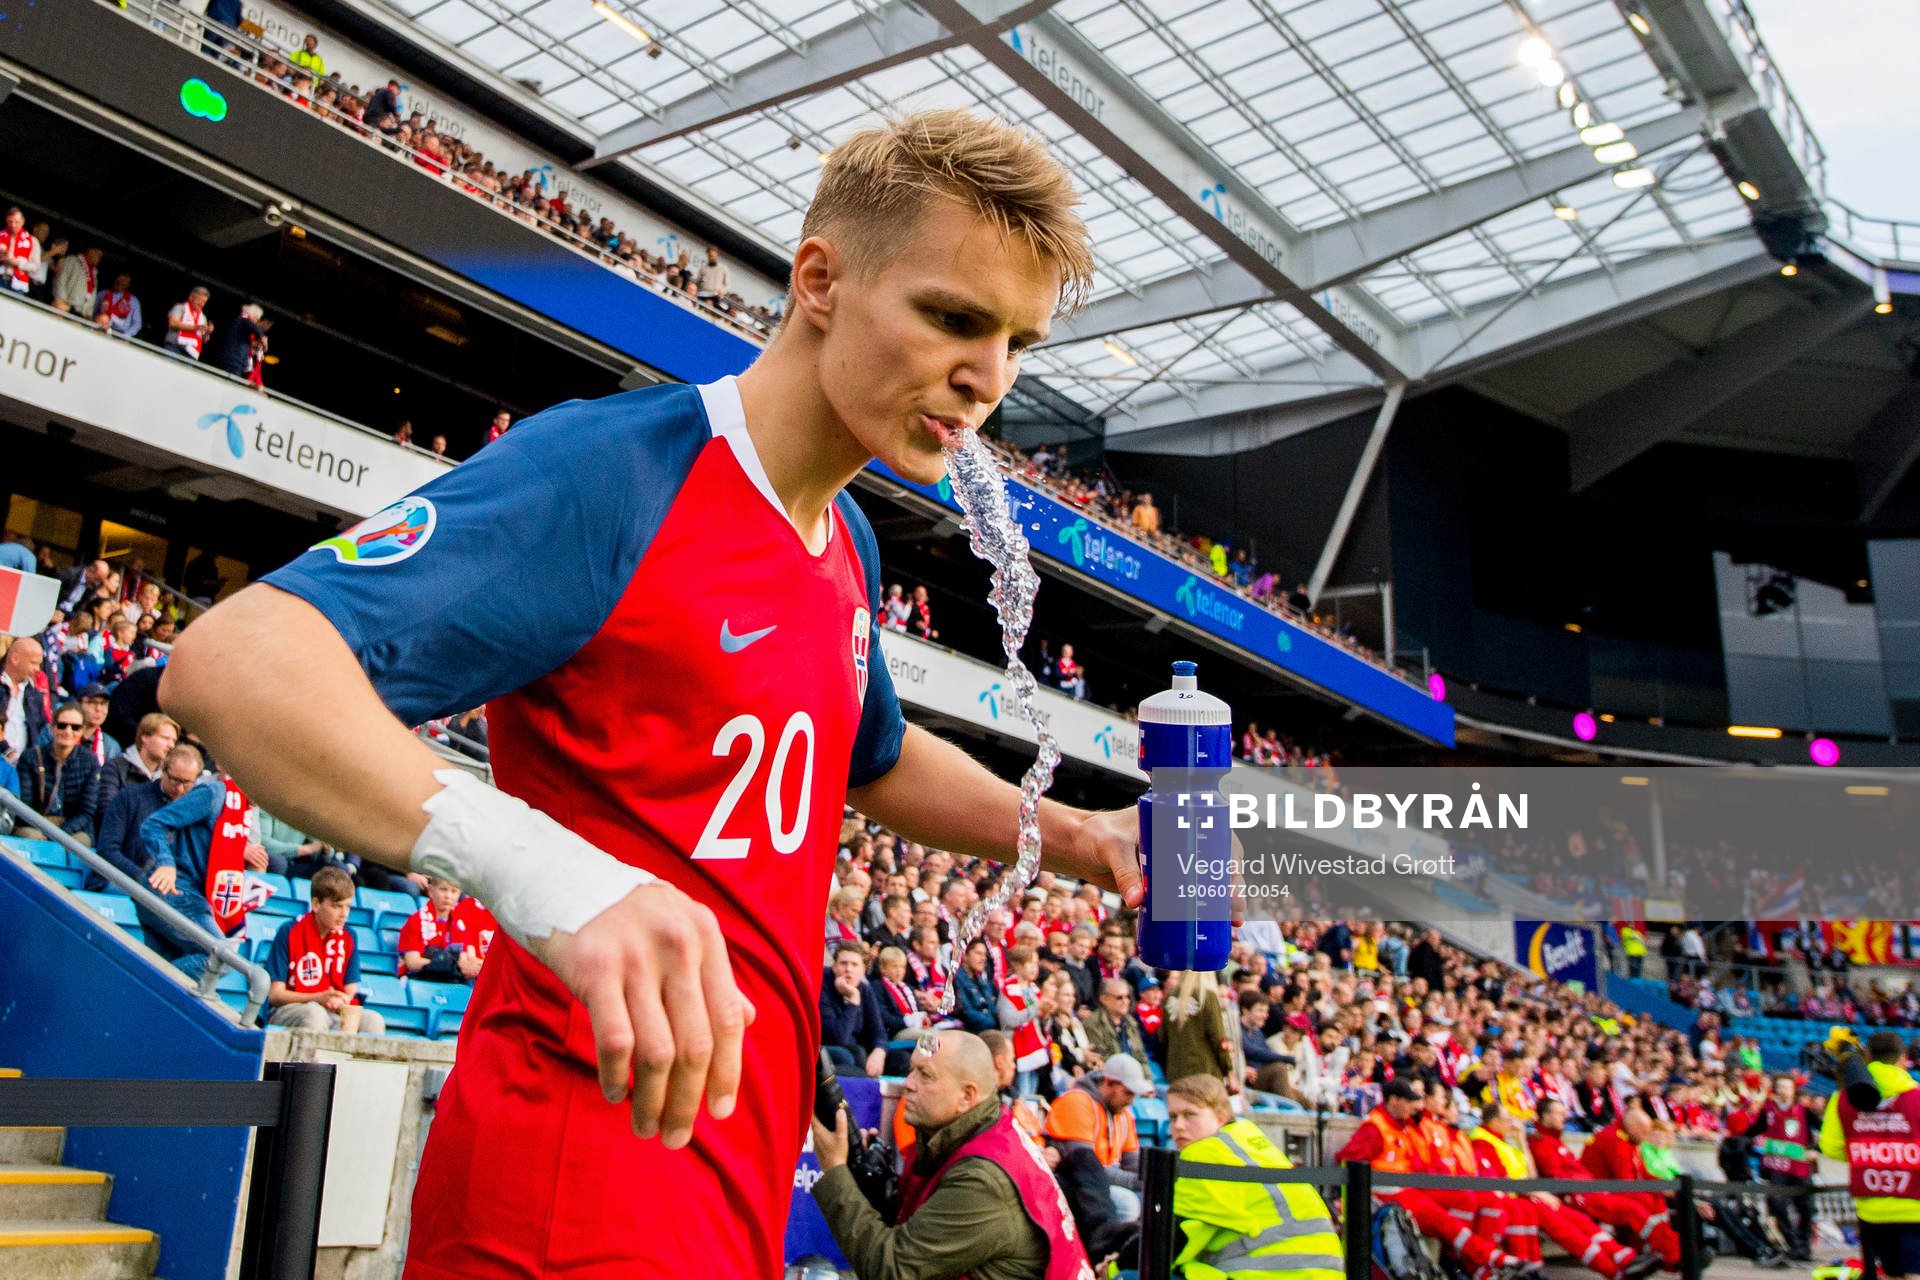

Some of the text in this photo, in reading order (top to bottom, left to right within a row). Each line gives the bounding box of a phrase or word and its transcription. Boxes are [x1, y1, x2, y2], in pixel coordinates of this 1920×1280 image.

[1030, 34, 1104, 118] telenor
[1227, 206, 1284, 268] telenor
[255, 421, 371, 489] telenor
[1084, 532, 1141, 581] telenor
[1195, 588, 1245, 632] telenor
[690, 710, 815, 860] 20
[1851, 1141, 1920, 1165] PHOTO
[1863, 1168, 1911, 1194] 037
